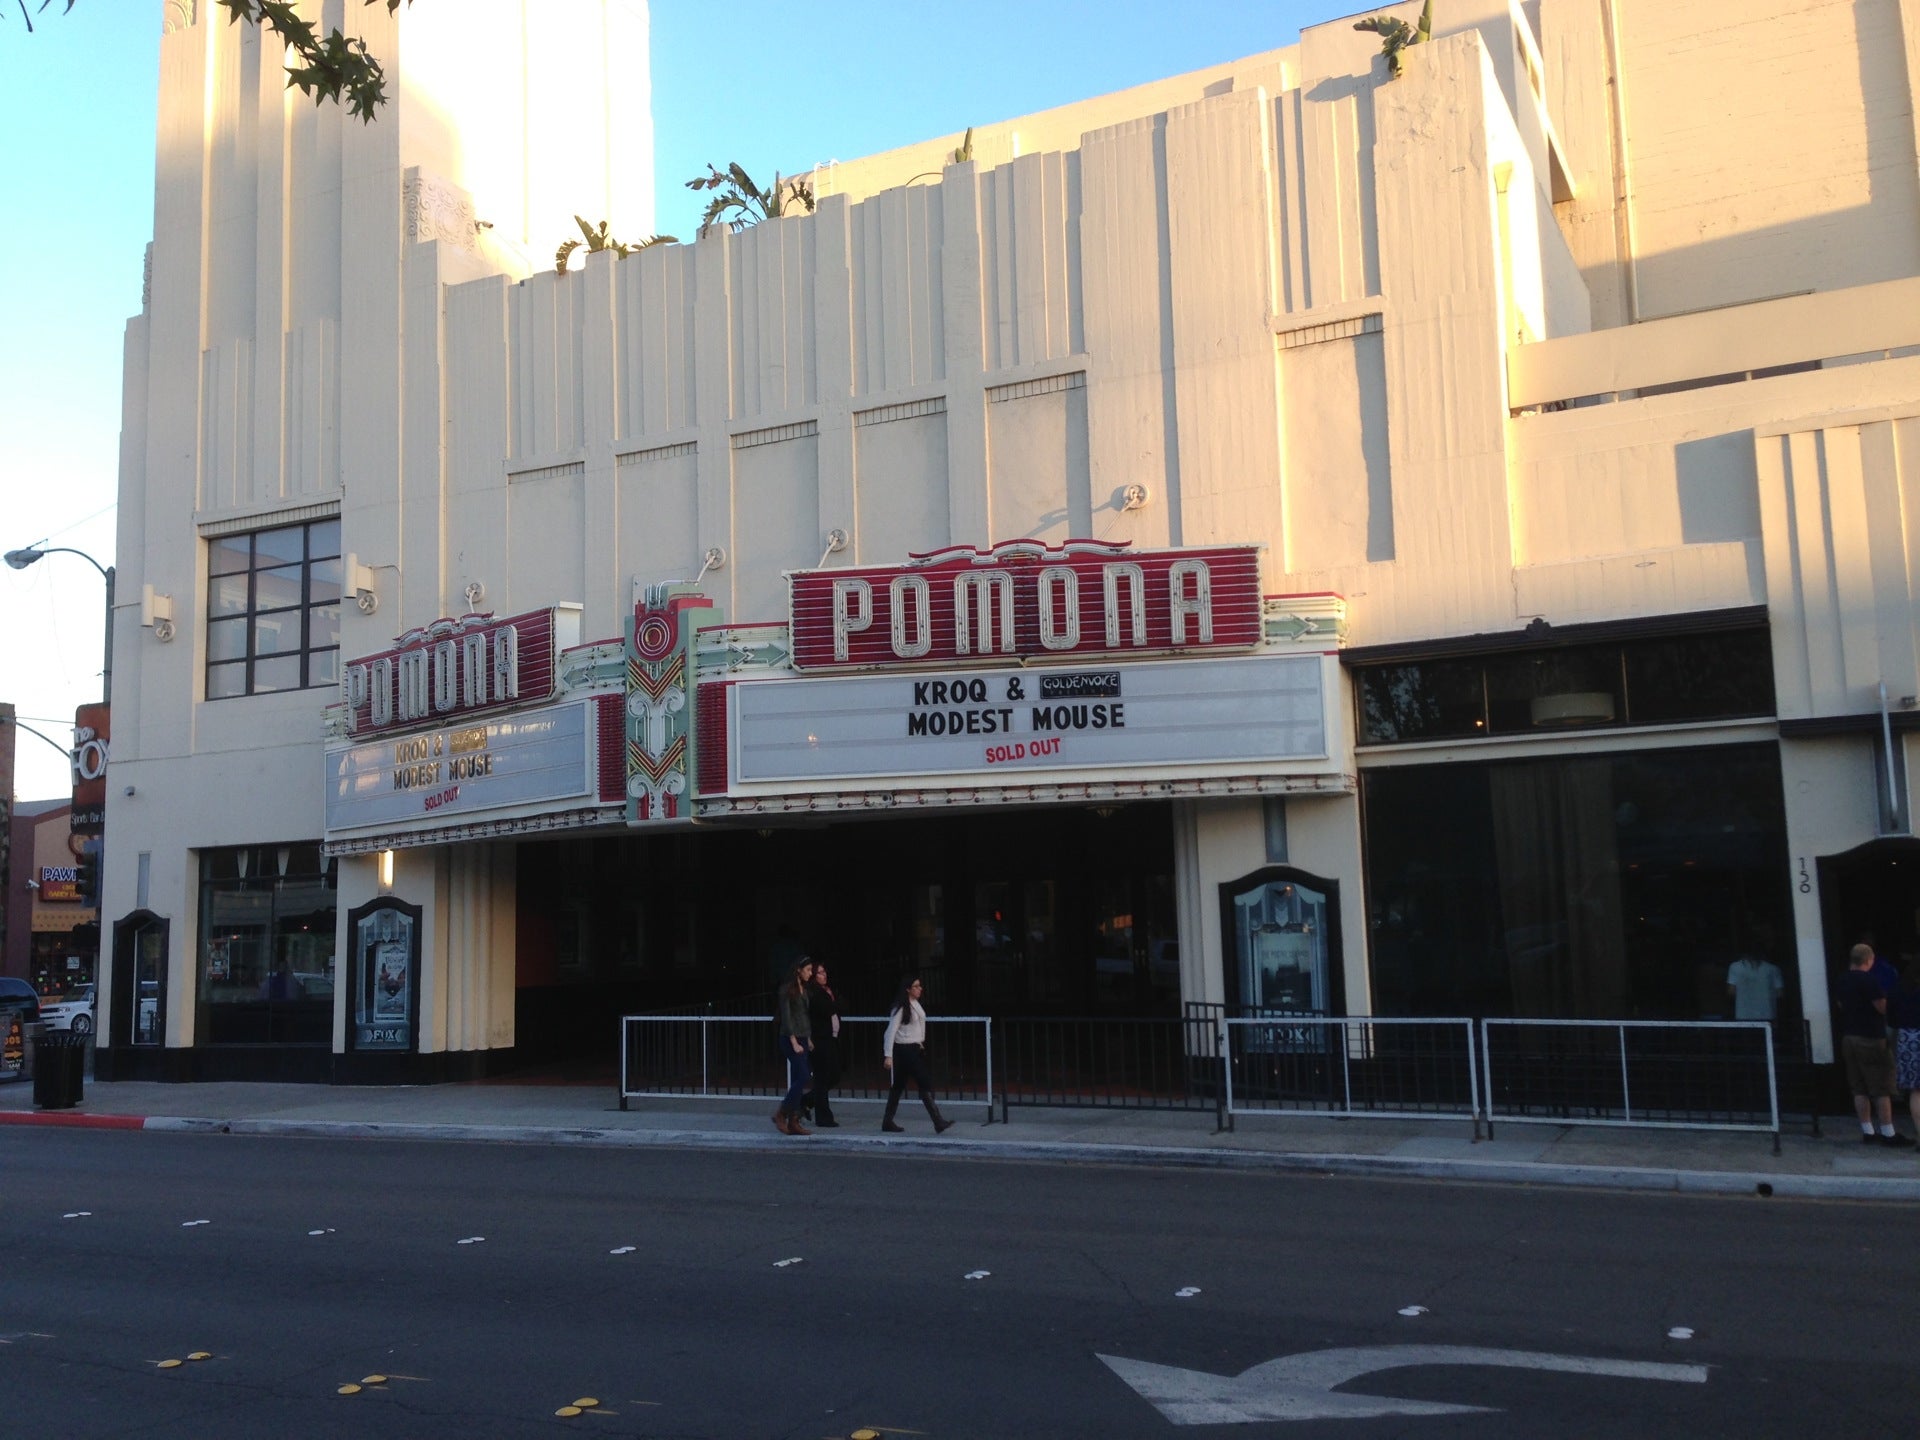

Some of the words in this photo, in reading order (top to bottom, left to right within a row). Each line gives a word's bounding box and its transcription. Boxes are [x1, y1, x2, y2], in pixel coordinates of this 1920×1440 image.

[833, 558, 1215, 662] POMONA
[347, 624, 519, 733] POMONA
[913, 677, 988, 706] KROQ
[1007, 676, 1026, 702] &
[1043, 674, 1118, 690] GOLDENVOICE
[908, 707, 1014, 736] MODEST
[1032, 704, 1126, 732] MOUSE
[394, 738, 428, 765] KROQ
[433, 735, 443, 757] &
[985, 743, 1026, 764] SOLD
[1030, 738, 1062, 757] OUT
[393, 762, 441, 791] MODEST
[448, 753, 493, 781] MOUSE
[424, 792, 443, 812] SOLD
[443, 785, 459, 804] OUT
[1799, 857, 1811, 894] 150
[373, 1029, 395, 1041] FOX
